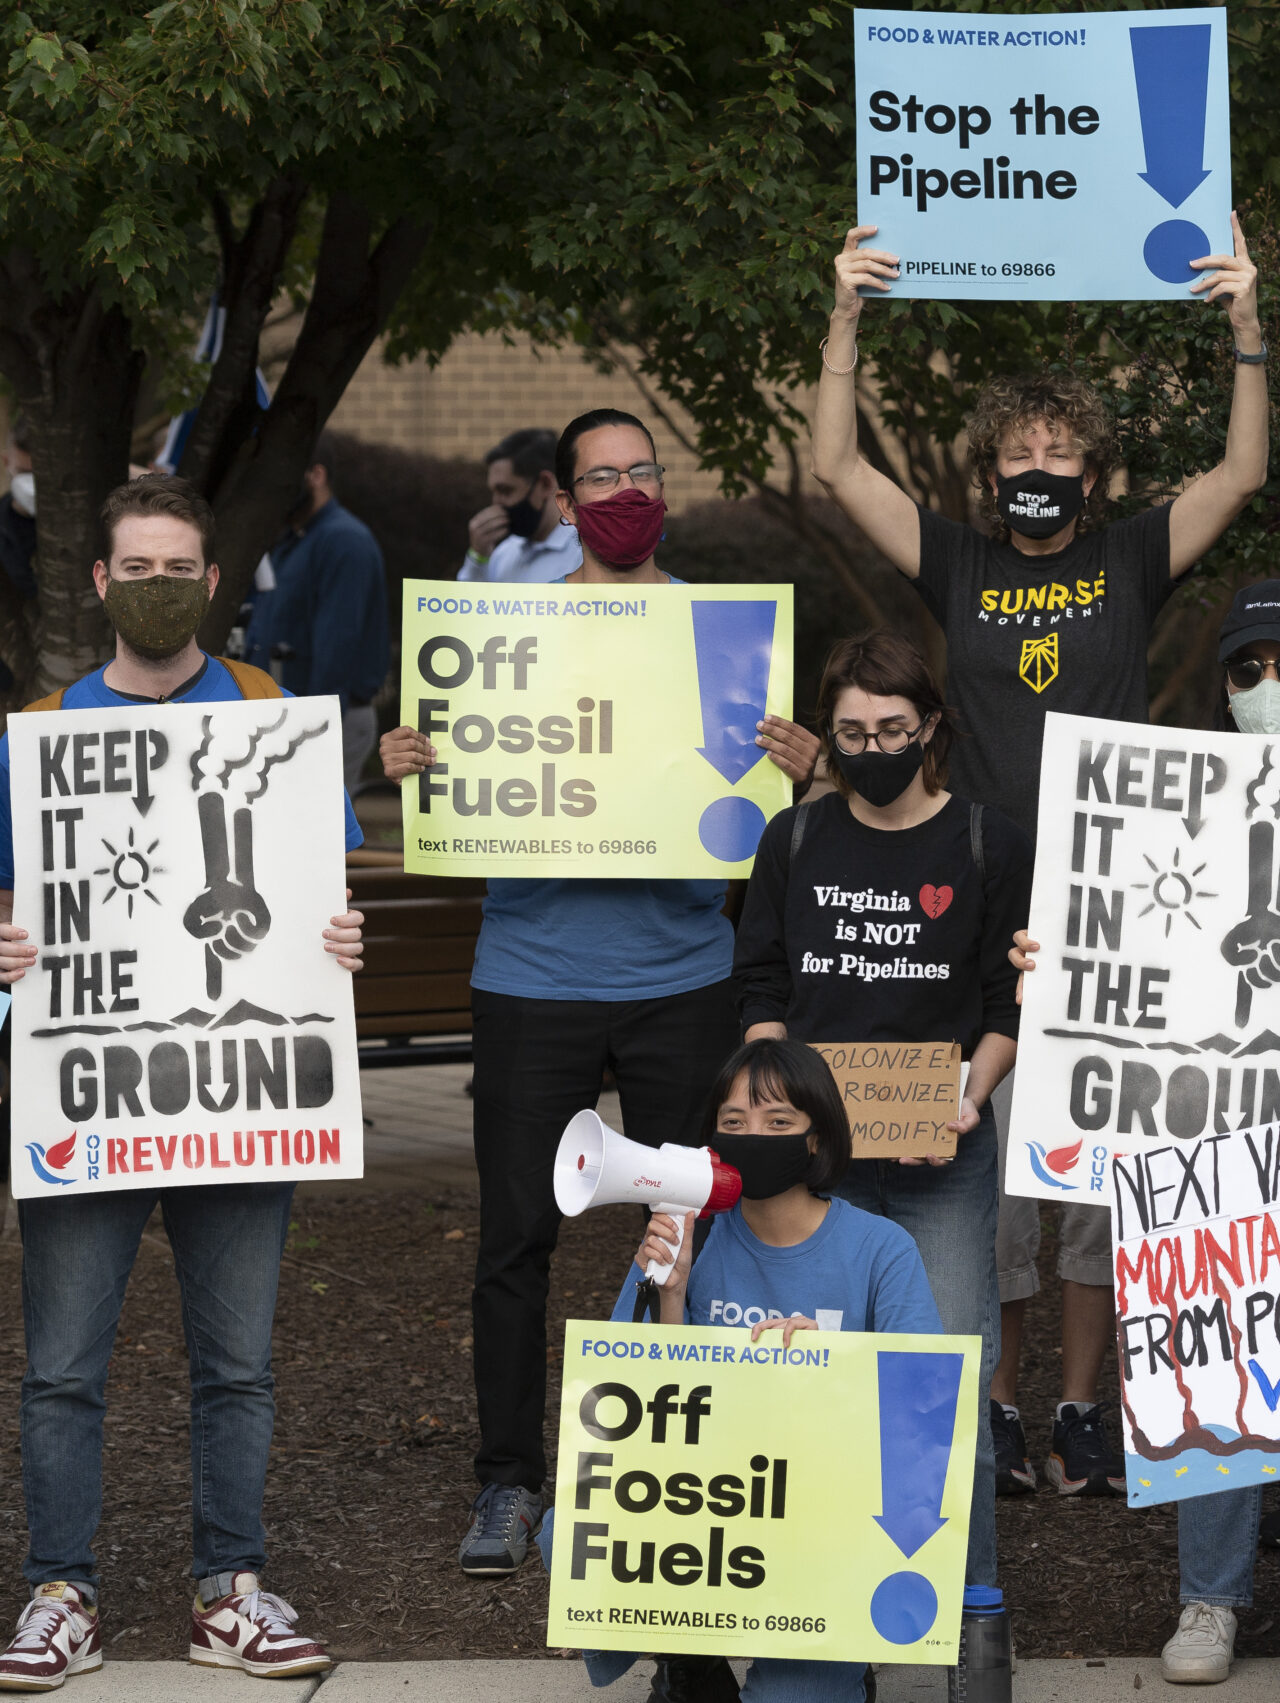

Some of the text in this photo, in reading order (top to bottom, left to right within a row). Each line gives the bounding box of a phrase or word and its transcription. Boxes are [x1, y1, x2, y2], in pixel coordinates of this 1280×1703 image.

[868, 26, 1087, 47] FOOD & WATER ACTION!
[868, 90, 1100, 149] Stop the
[869, 153, 1077, 212] Pipeline
[906, 261, 977, 276] PIPELINE
[981, 264, 997, 276] to
[1001, 263, 1056, 277] 69866
[1009, 503, 1060, 518] PIPELINE
[1016, 492, 1049, 504] STOP
[417, 597, 646, 617] FOOD & WATER ACTION!
[980, 570, 1105, 614] SUNRSE
[417, 635, 537, 690] Off
[417, 696, 613, 754] Fossil
[39, 728, 169, 815] KEEP
[418, 763, 597, 817] Fuels
[1075, 739, 1227, 838] KEEP
[42, 807, 83, 872] IT
[418, 837, 657, 855] text RENEWABLES to 69866
[1071, 811, 1125, 876] IT
[42, 880, 90, 945] IN
[813, 885, 911, 913] Virginia
[1065, 885, 1124, 952] IN
[835, 919, 920, 945] is NOT
[42, 949, 139, 1018] THE
[801, 952, 950, 982] for Pipelines
[1061, 957, 1170, 1030] THE
[59, 1035, 334, 1122] GROUND
[85, 1134, 100, 1181] OUR
[106, 1128, 341, 1174] REVOLUTION
[1090, 1145, 1107, 1192] OUR
[1113, 1134, 1231, 1241] NEXT
[581, 1339, 830, 1368] FOOD & WATER ACTION!
[1119, 1298, 1233, 1382] FROM
[579, 1382, 712, 1445] Off
[574, 1451, 788, 1519] Fossil
[570, 1521, 766, 1589] Fuels
[566, 1606, 604, 1623] text
[608, 1608, 737, 1629] RENEWABLES
[742, 1614, 761, 1630] to
[764, 1615, 826, 1634] 69866
